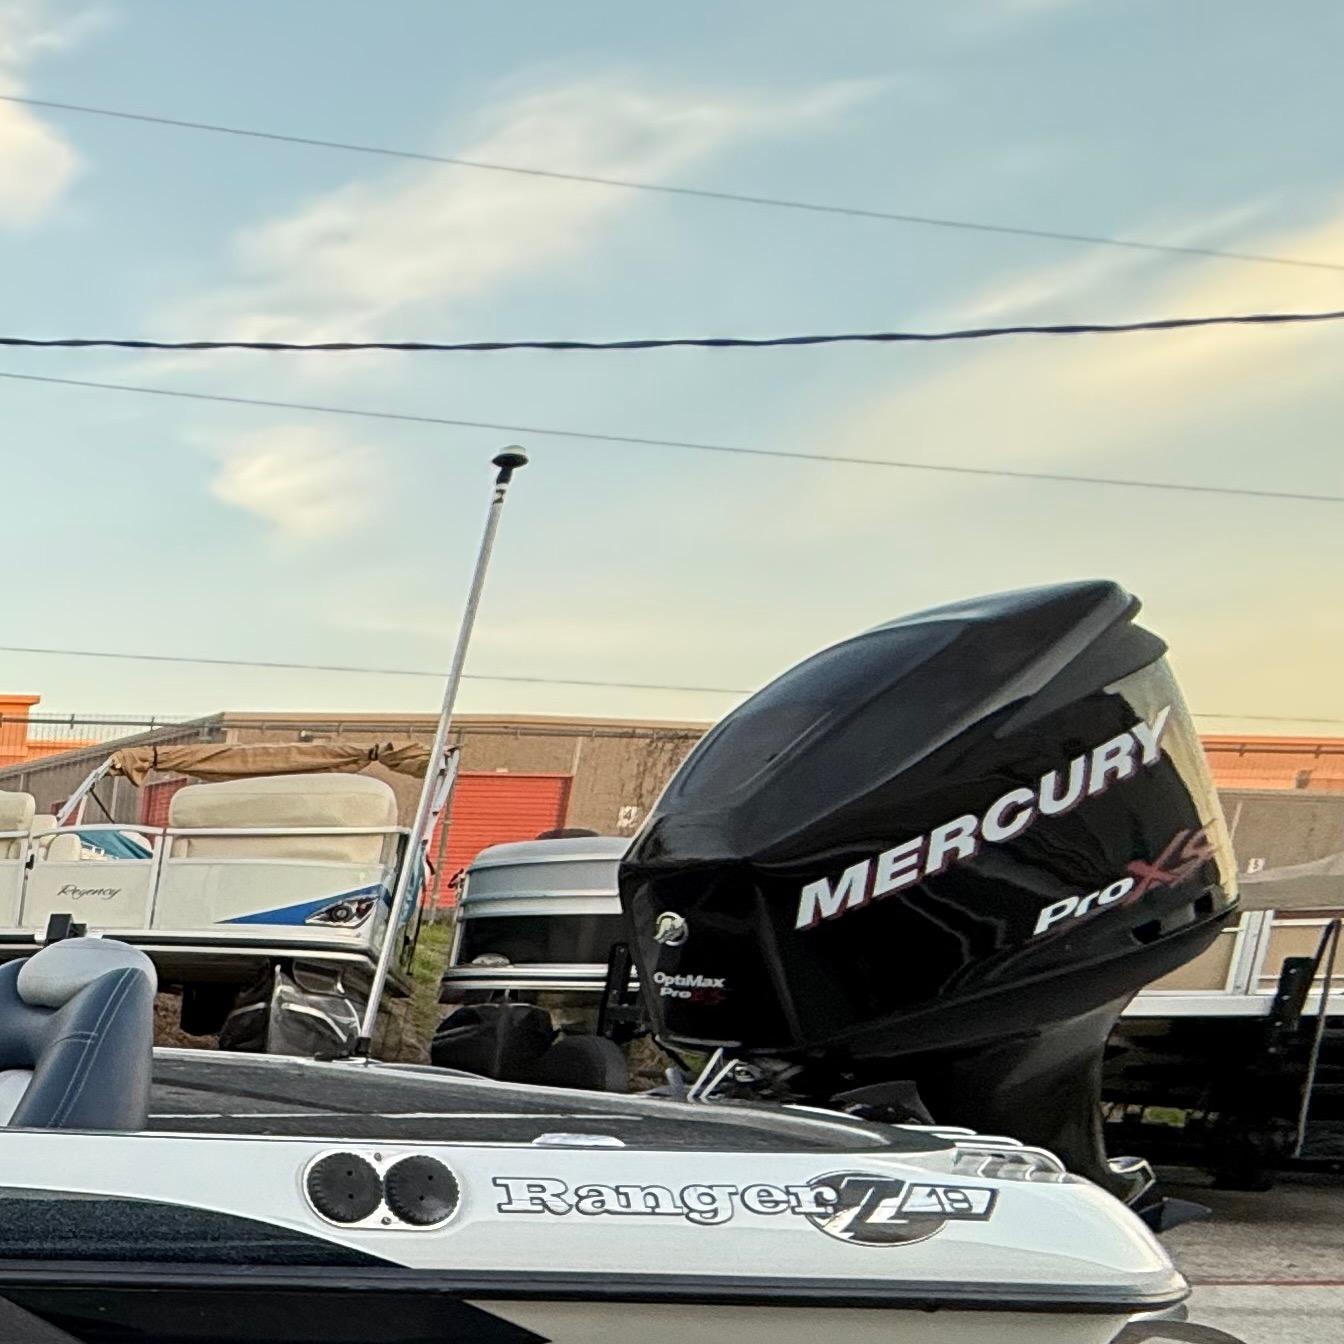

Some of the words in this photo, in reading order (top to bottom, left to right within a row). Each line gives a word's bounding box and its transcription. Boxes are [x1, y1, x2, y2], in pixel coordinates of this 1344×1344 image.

[795, 705, 1172, 930] MERCURY
[56, 883, 122, 901] Regency
[653, 971, 725, 988] OptiMax
[492, 1176, 840, 1226] Ranger
